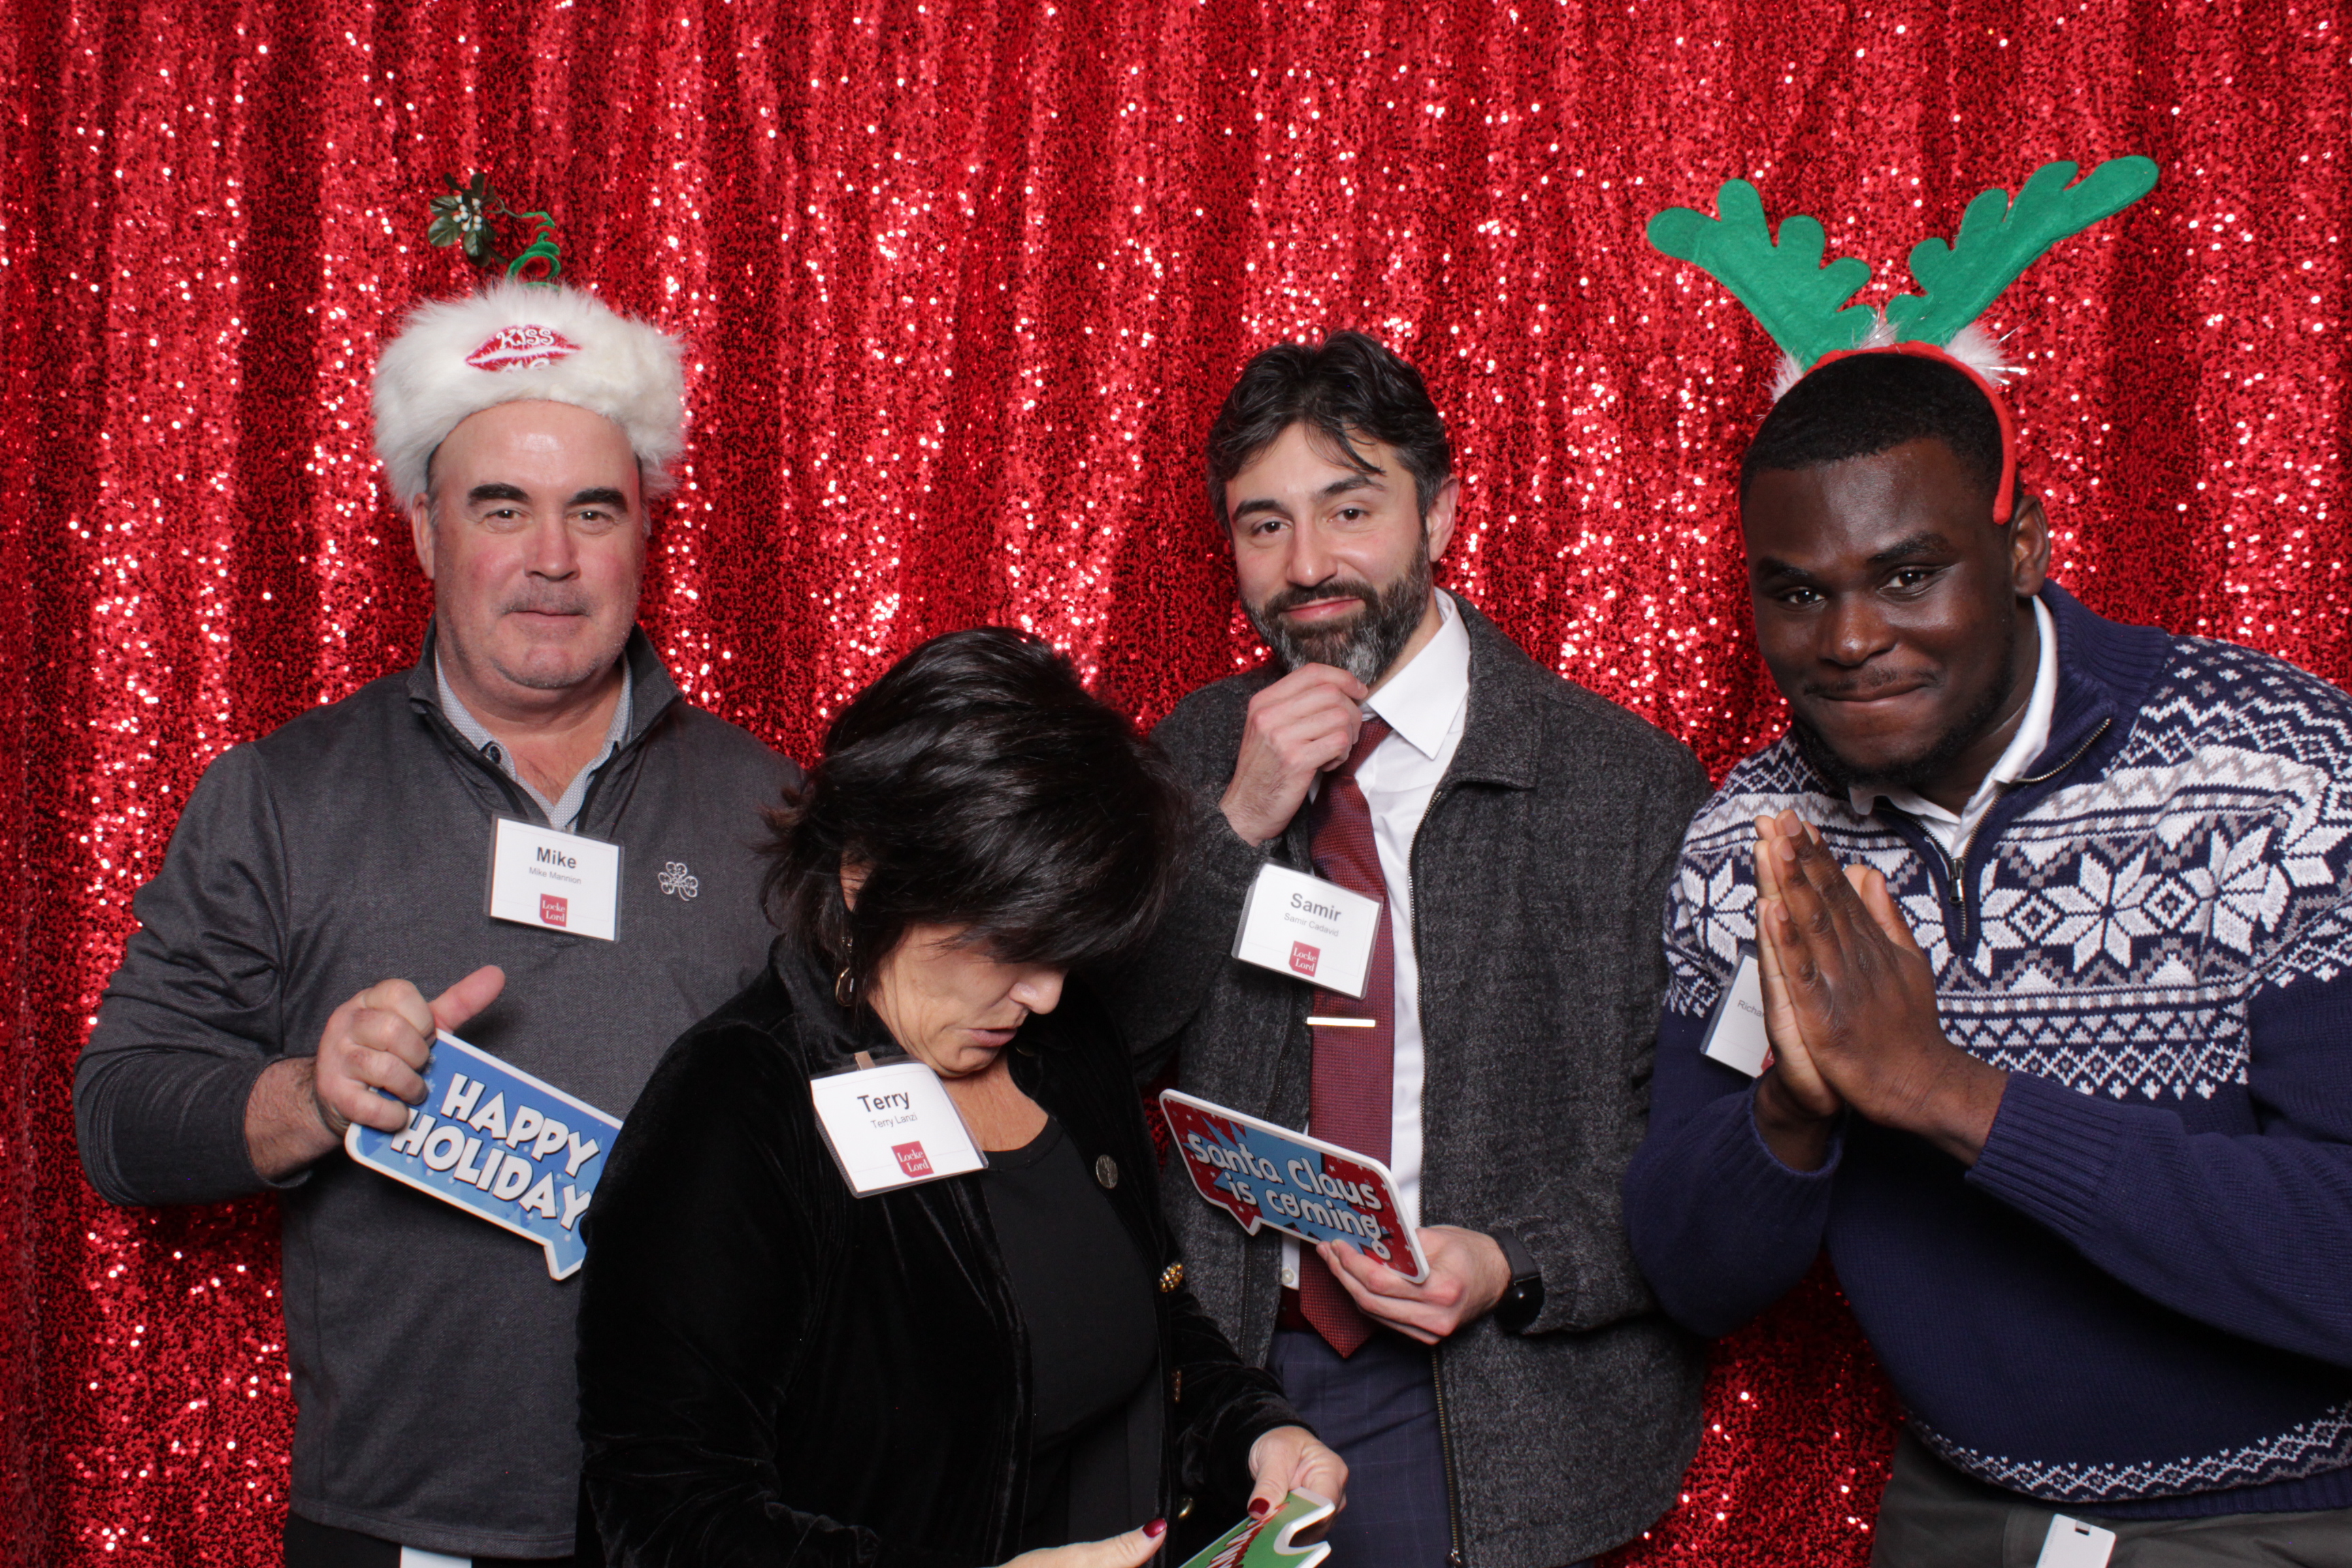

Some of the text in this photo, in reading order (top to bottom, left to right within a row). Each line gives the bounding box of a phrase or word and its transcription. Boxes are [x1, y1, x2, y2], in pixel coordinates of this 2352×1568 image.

[496, 328, 555, 349] KISS
[536, 847, 576, 868] Mike
[529, 866, 582, 884] Mike Mannion
[542, 900, 566, 913] Locke
[1290, 893, 1341, 921] Samir
[546, 911, 565, 922] Lord
[1284, 913, 1339, 936] Samir Cadavid
[1293, 947, 1317, 962] Locke
[1295, 958, 1315, 972] Lord
[857, 1092, 910, 1112] Terry
[440, 1072, 600, 1178] HAPPY
[870, 1112, 918, 1129] Terry Lanzi
[897, 1149, 924, 1163] Locke
[391, 1107, 591, 1230] HOLIDAY
[906, 1160, 930, 1173] Lord
[1225, 1172, 1392, 1261] is coming
